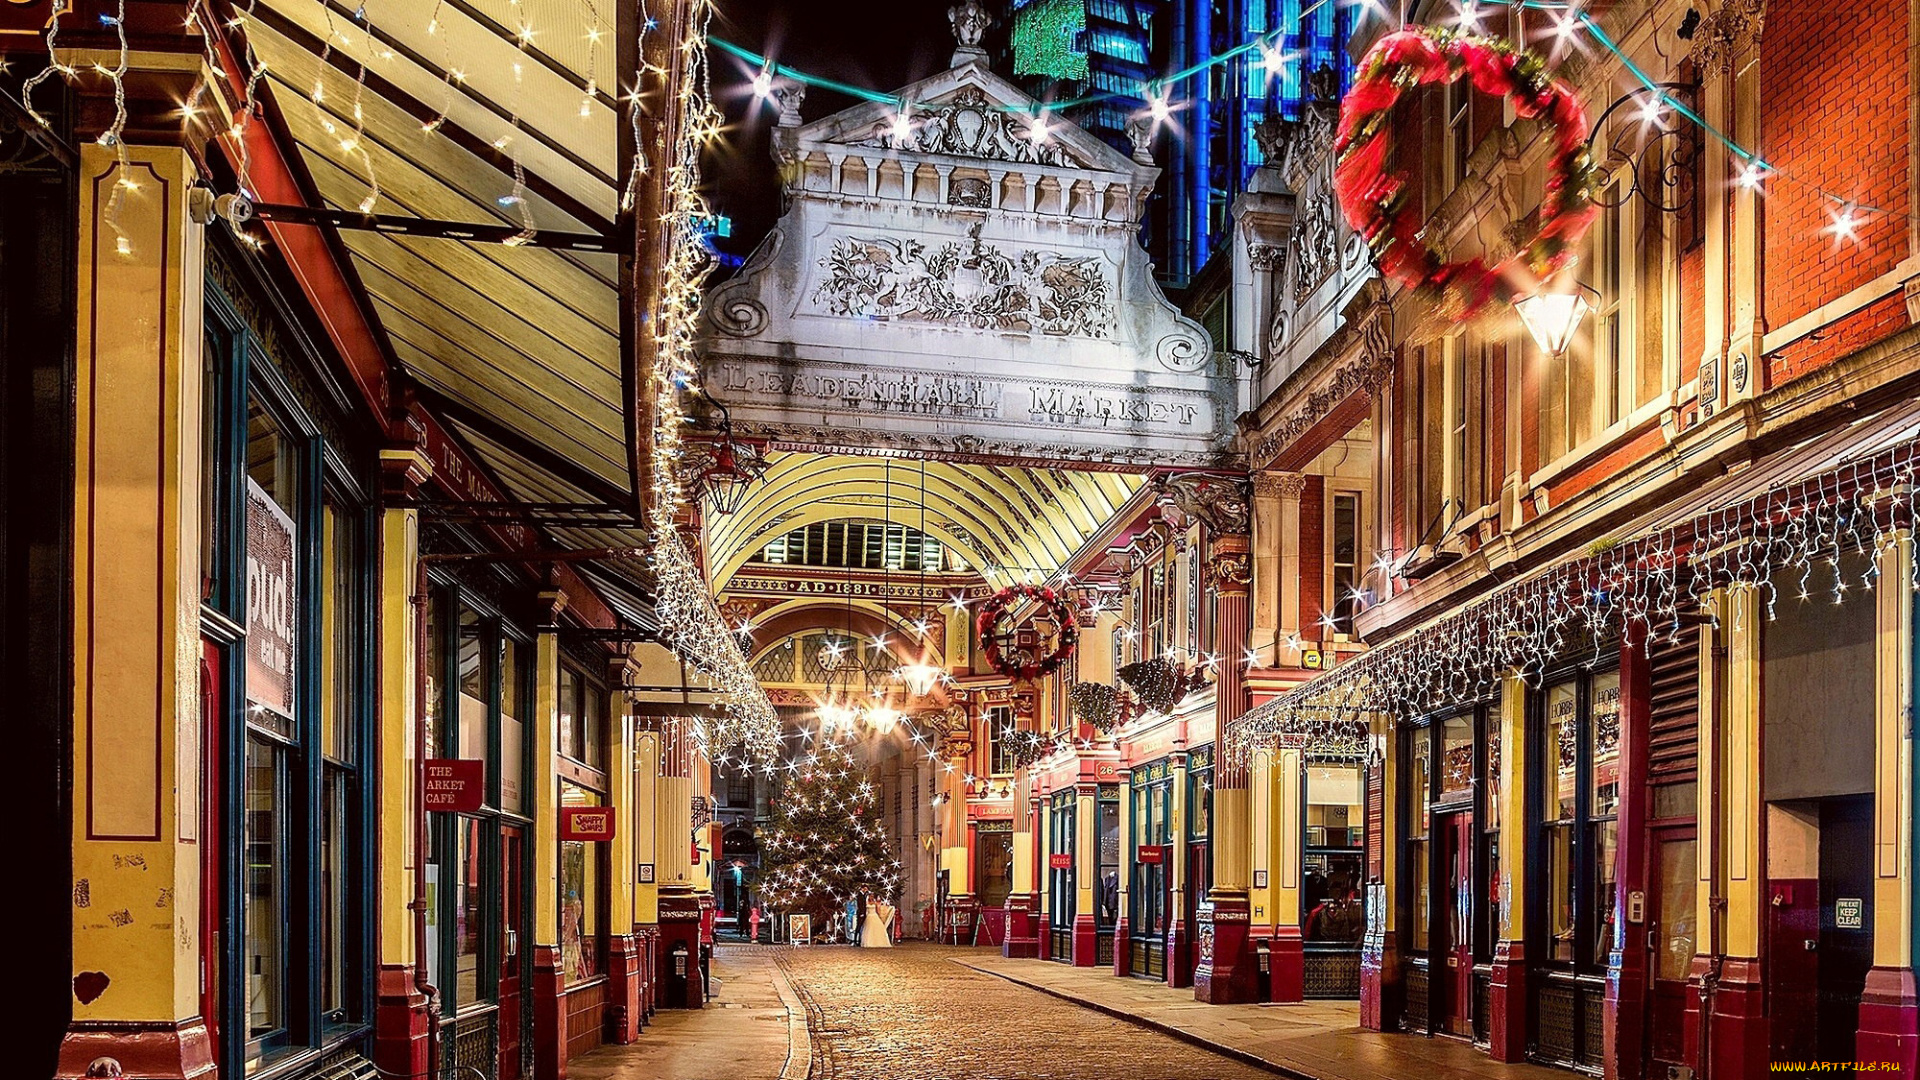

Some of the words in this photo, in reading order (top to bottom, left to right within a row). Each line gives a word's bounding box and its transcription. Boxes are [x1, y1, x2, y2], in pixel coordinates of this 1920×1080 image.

[724, 363, 998, 411] LEADENHALL
[1028, 385, 1199, 425] MARKET
[441, 442, 462, 484] THE
[836, 583, 871, 595] 1881
[1598, 687, 1620, 706] HOBB
[429, 766, 453, 777] THE
[1099, 765, 1114, 775] 26
[426, 780, 466, 790] ARKET
[576, 814, 605, 826] SNAPPY
[580, 823, 604, 832] SNAPS
[1052, 857, 1070, 865] REISS
[1840, 907, 1858, 917] KEEP
[1837, 916, 1861, 925] CLEAR
